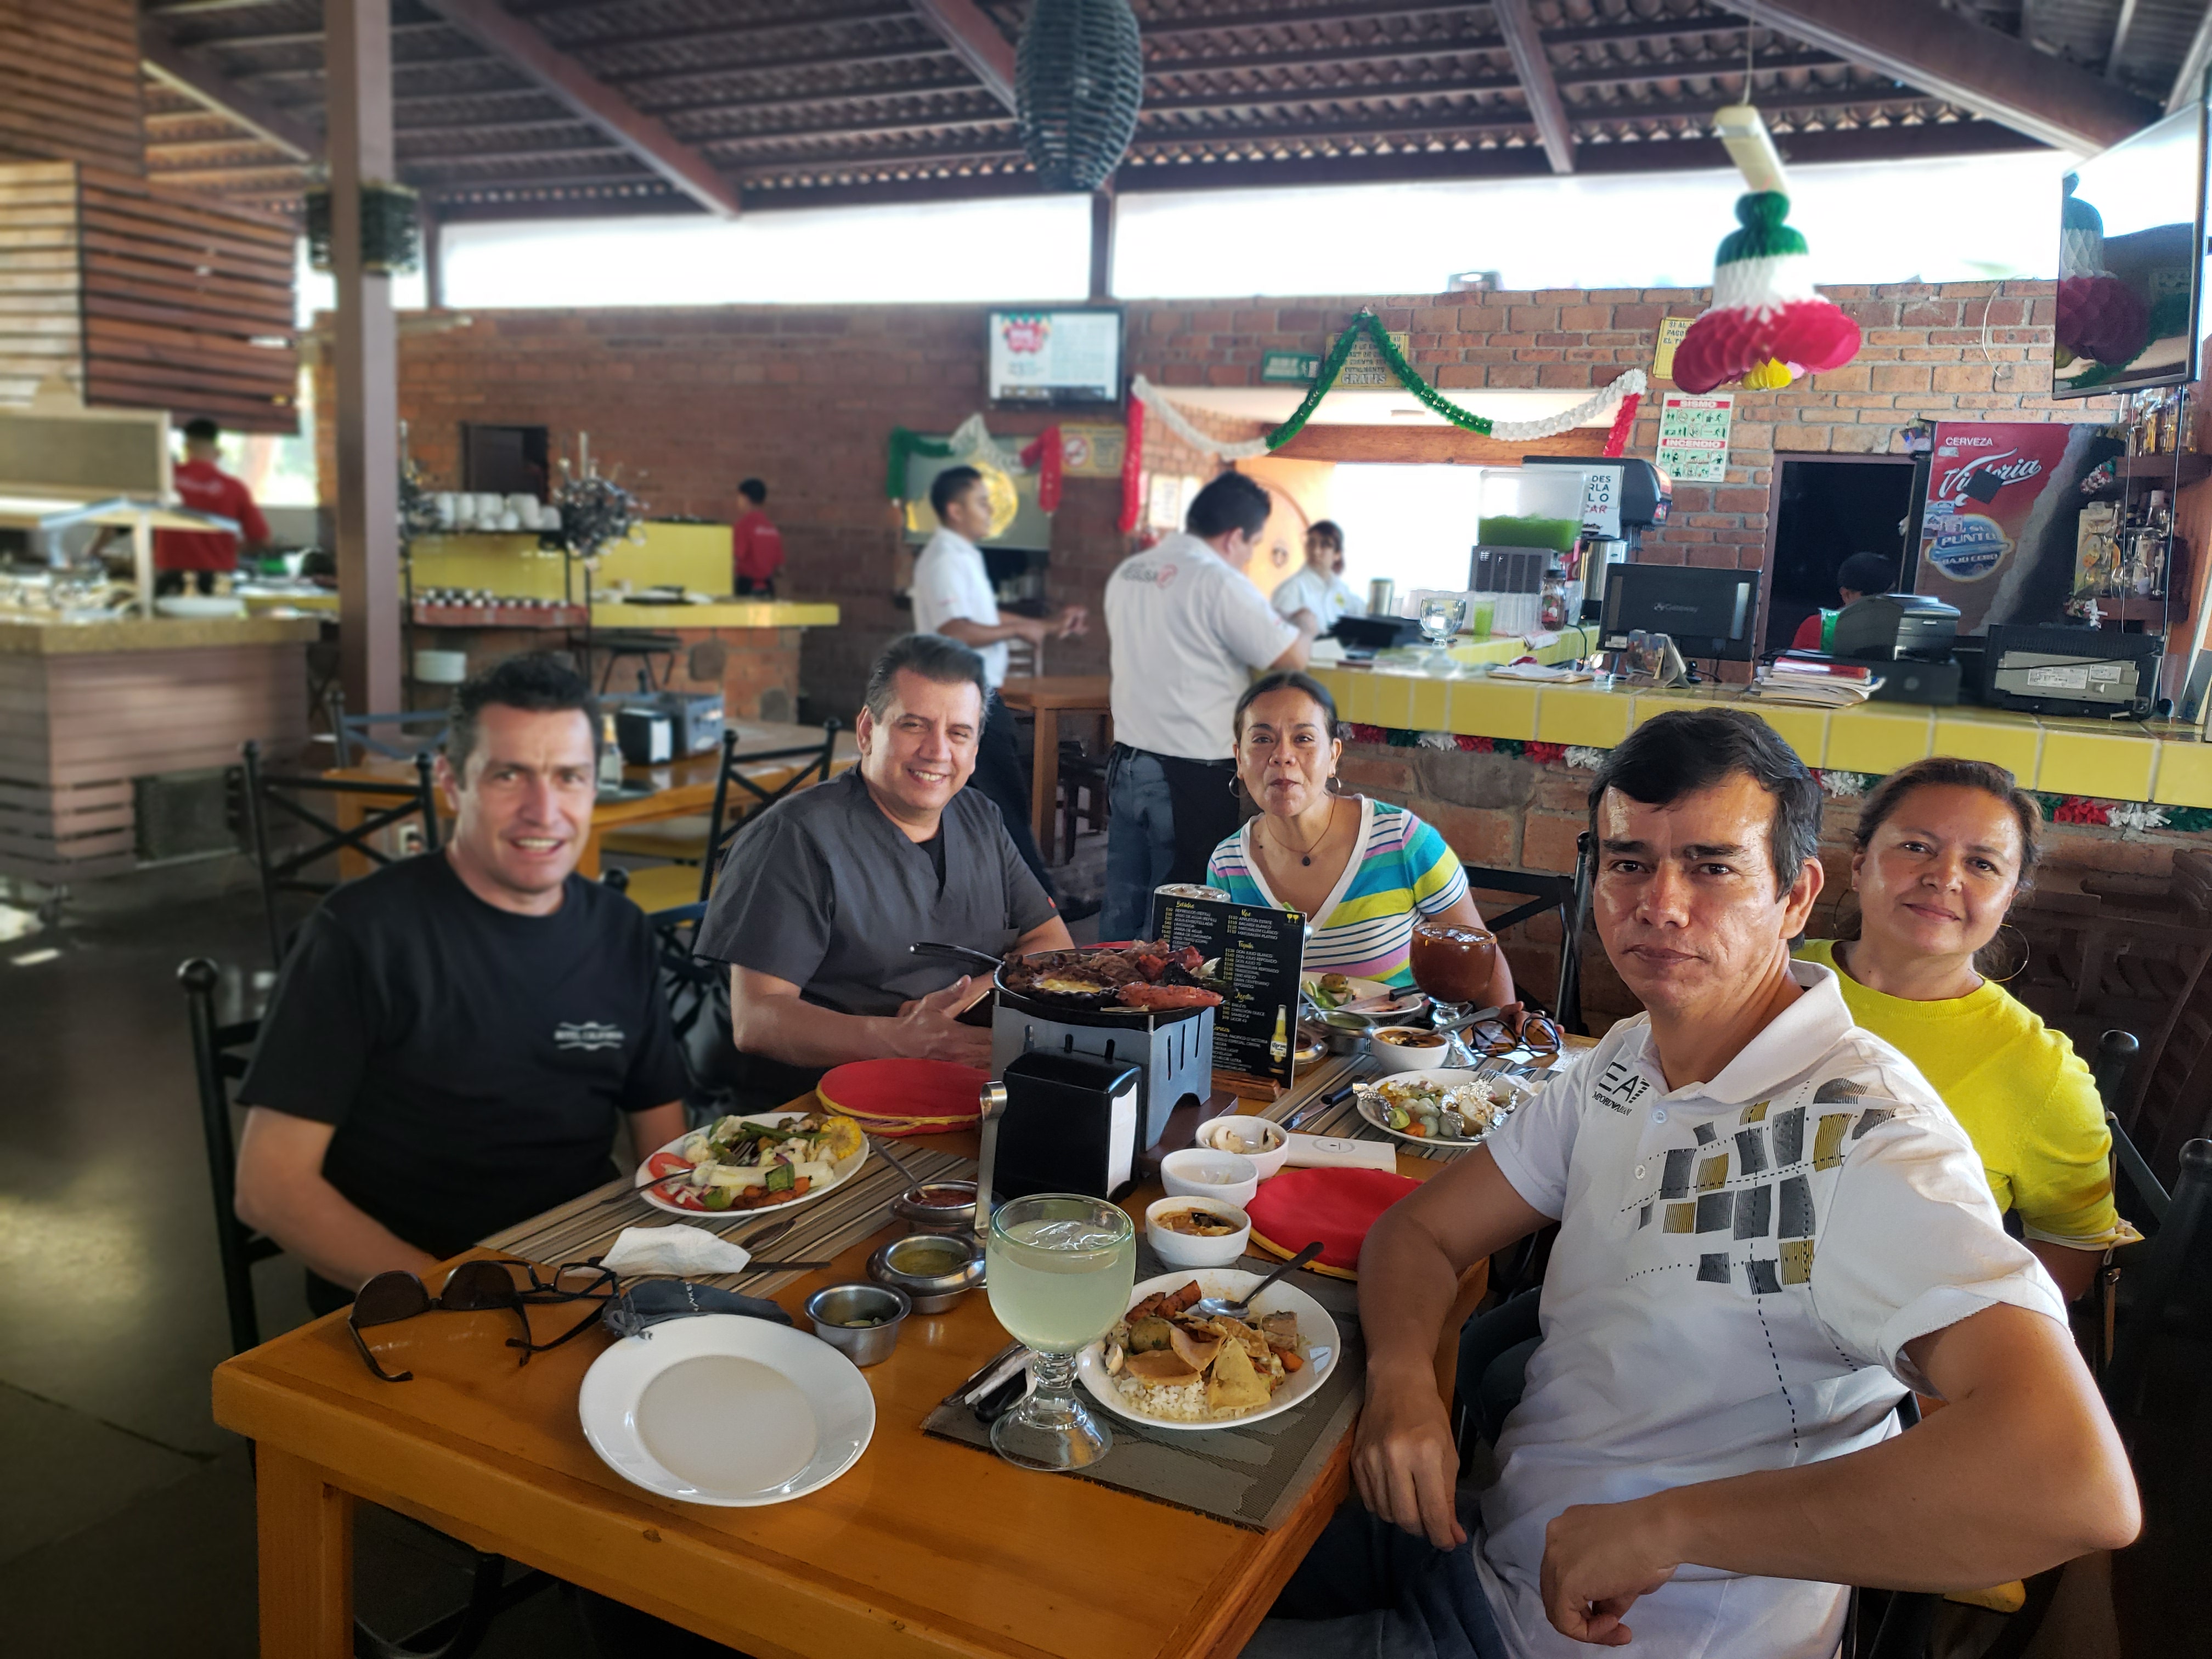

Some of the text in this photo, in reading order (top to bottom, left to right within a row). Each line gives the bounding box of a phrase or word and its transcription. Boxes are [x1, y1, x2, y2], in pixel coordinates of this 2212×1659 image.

[1342, 374, 1386, 384] GRATIS
[1680, 400, 1717, 409] SISMO
[1667, 439, 1721, 448] INCENDIO
[1945, 437, 1993, 446] CERVEZA
[1939, 447, 2042, 500] Vioria
[1941, 532, 1999, 546] PUNTO
[1942, 553, 1998, 565] BAJO CERO
[1599, 1062, 1650, 1104] EA7
